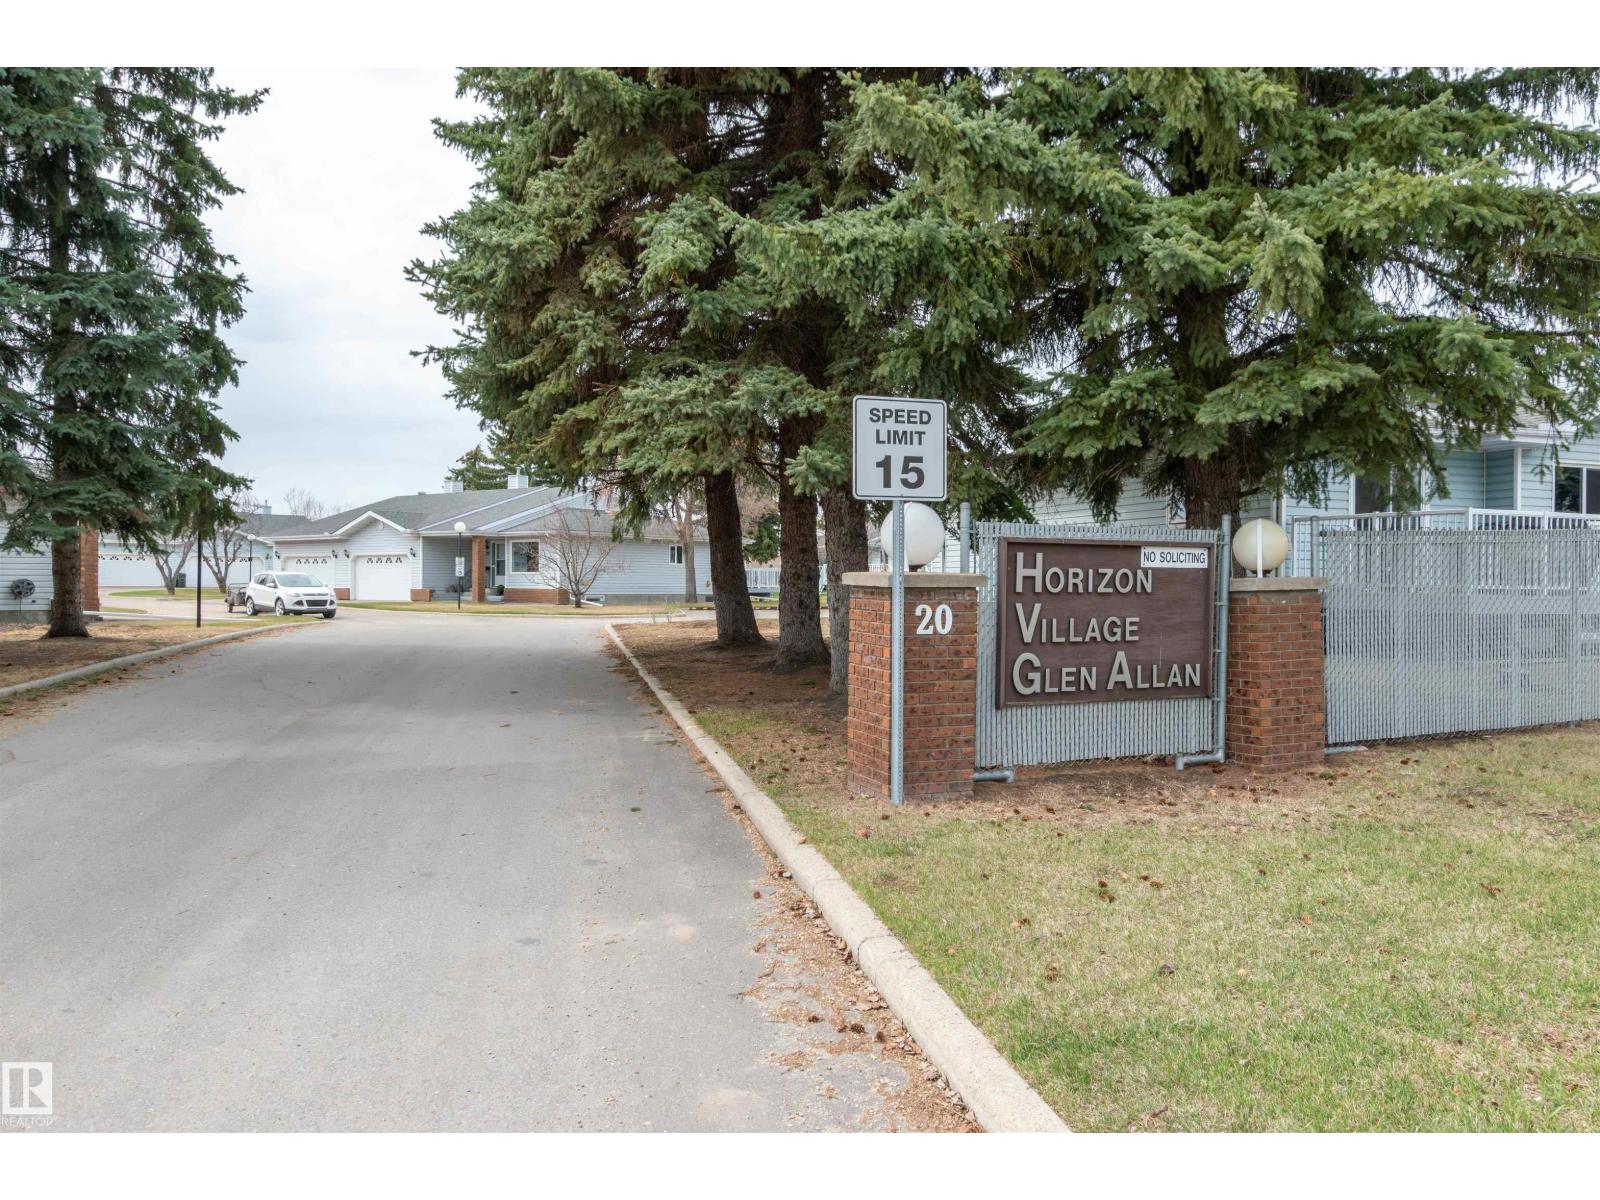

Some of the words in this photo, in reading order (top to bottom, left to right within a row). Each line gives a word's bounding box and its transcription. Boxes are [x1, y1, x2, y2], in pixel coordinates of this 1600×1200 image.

[869, 408, 932, 425] SPEED
[875, 429, 926, 445] LIMIT
[876, 455, 925, 489] 15
[1015, 551, 1153, 594] HORIZON
[1143, 551, 1156, 563] NO
[1159, 551, 1206, 564] SOLICITING
[915, 604, 953, 635] 20
[1015, 602, 1140, 643] VILLAGE
[1012, 652, 1097, 695] GLEN
[1107, 650, 1201, 690] ALLAN
